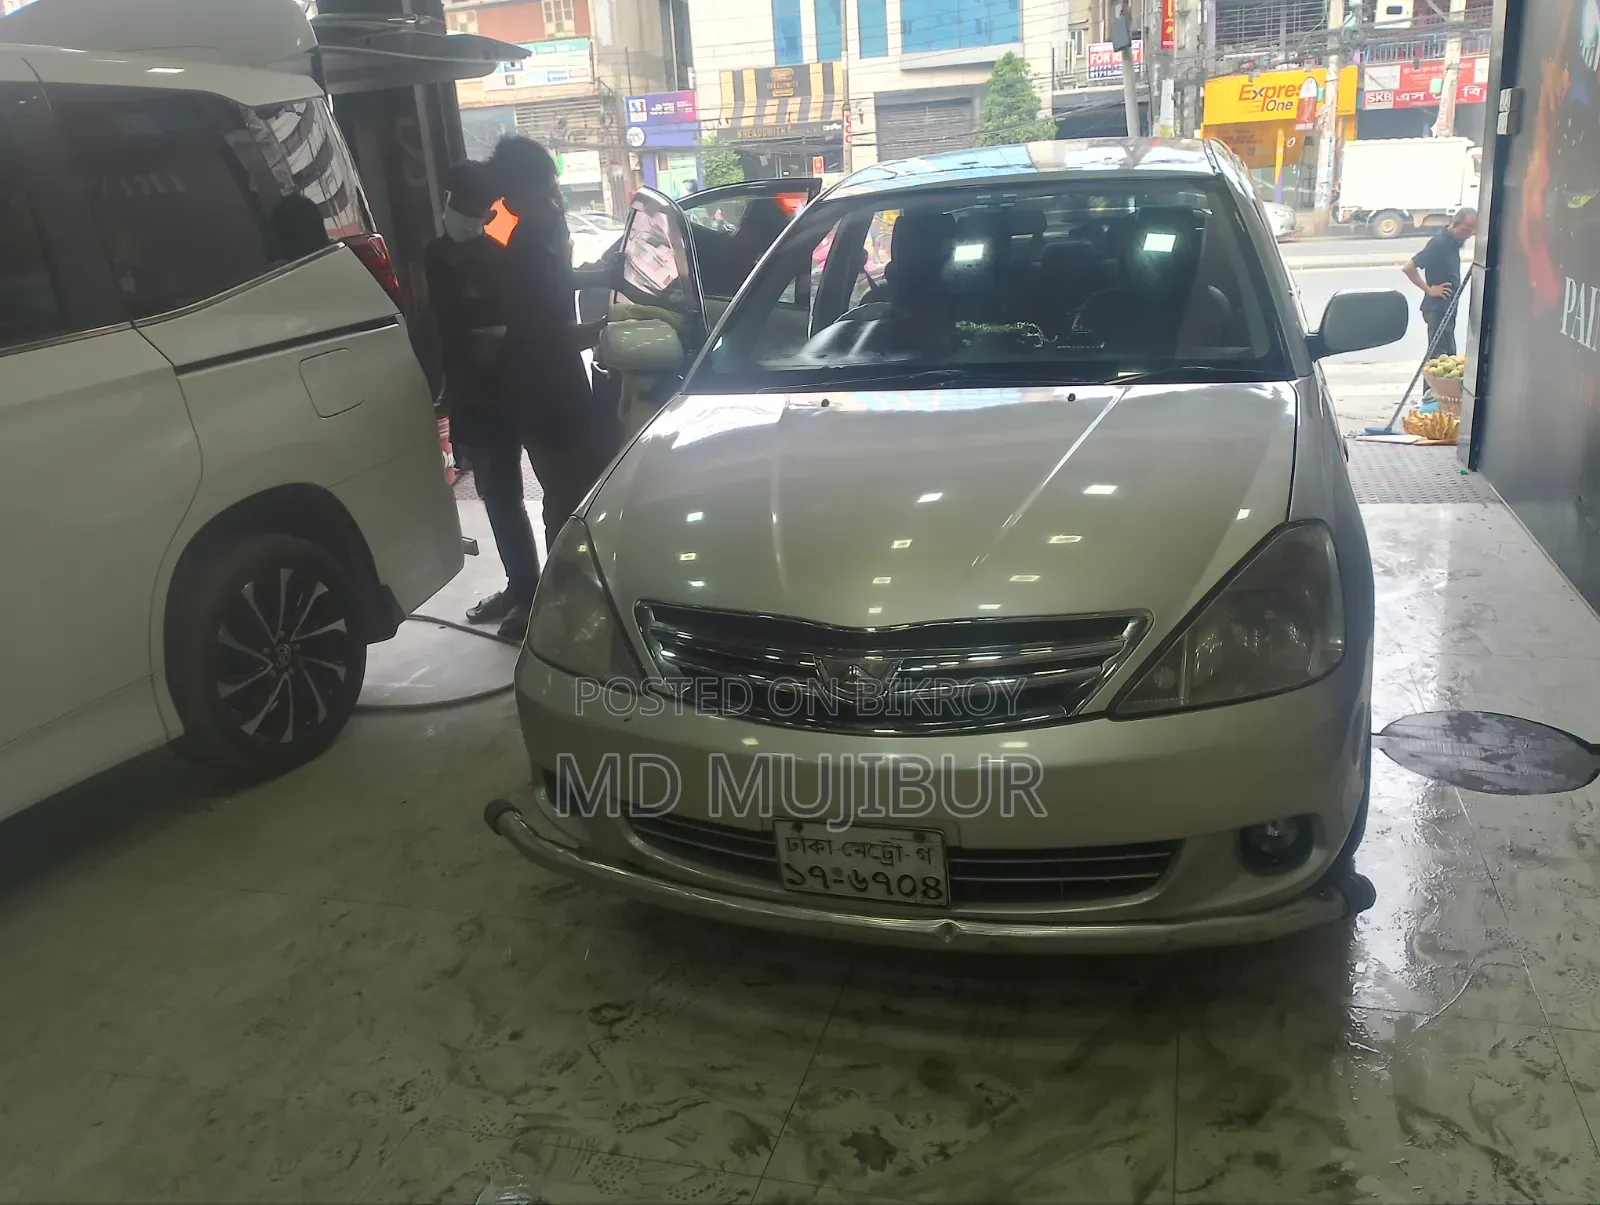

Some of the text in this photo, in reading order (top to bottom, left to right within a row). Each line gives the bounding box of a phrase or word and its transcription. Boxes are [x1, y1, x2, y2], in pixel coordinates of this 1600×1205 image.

[1368, 91, 1393, 103] SKB
[1266, 100, 1293, 112] One
[786, 836, 833, 855] ঢাকা
[785, 862, 943, 899] ১৭-৬৭০৪
